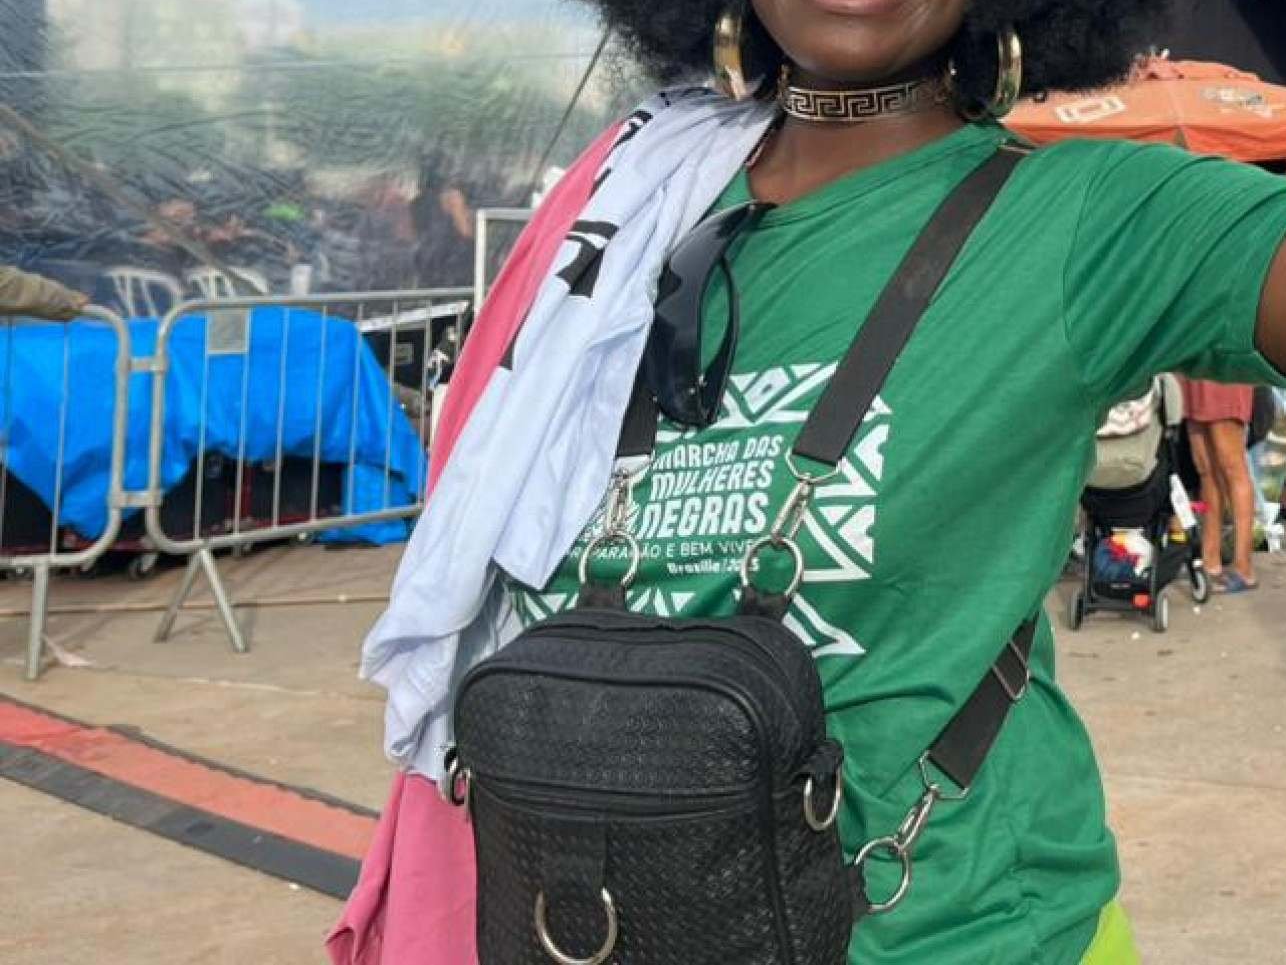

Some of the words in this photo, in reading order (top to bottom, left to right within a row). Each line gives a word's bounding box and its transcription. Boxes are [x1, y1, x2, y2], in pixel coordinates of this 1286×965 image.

[652, 440, 740, 470] MARCHA
[743, 434, 784, 460] DAS
[649, 460, 775, 501] MULHERES
[636, 491, 769, 539] NEGRAS
[666, 542, 675, 557] E
[681, 540, 713, 557] BEM
